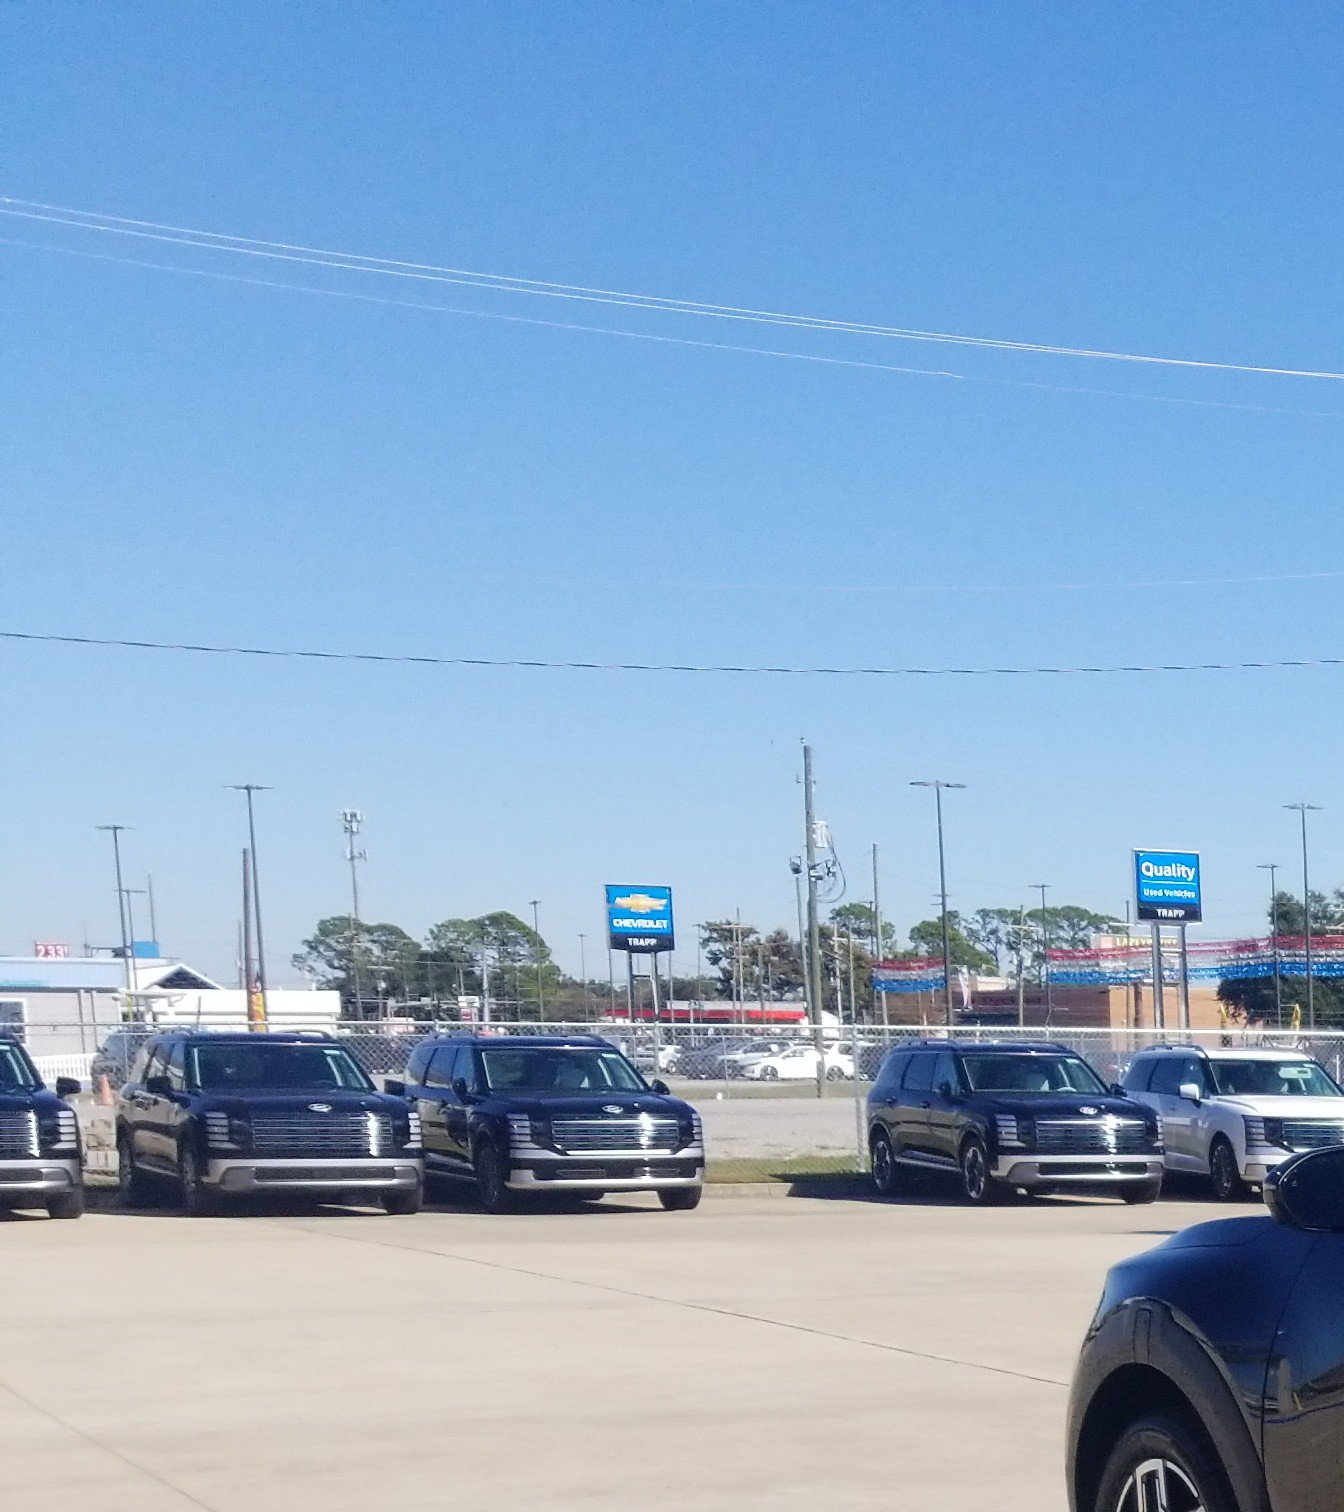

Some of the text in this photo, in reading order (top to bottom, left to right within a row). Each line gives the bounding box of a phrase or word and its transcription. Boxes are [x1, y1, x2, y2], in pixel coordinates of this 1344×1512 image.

[1141, 861, 1196, 881] Quality
[1143, 888, 1196, 899] Used Vehicles
[1156, 909, 1185, 918] TRAPP
[613, 918, 667, 929] CHEVROLET
[627, 937, 657, 946] TRAPP
